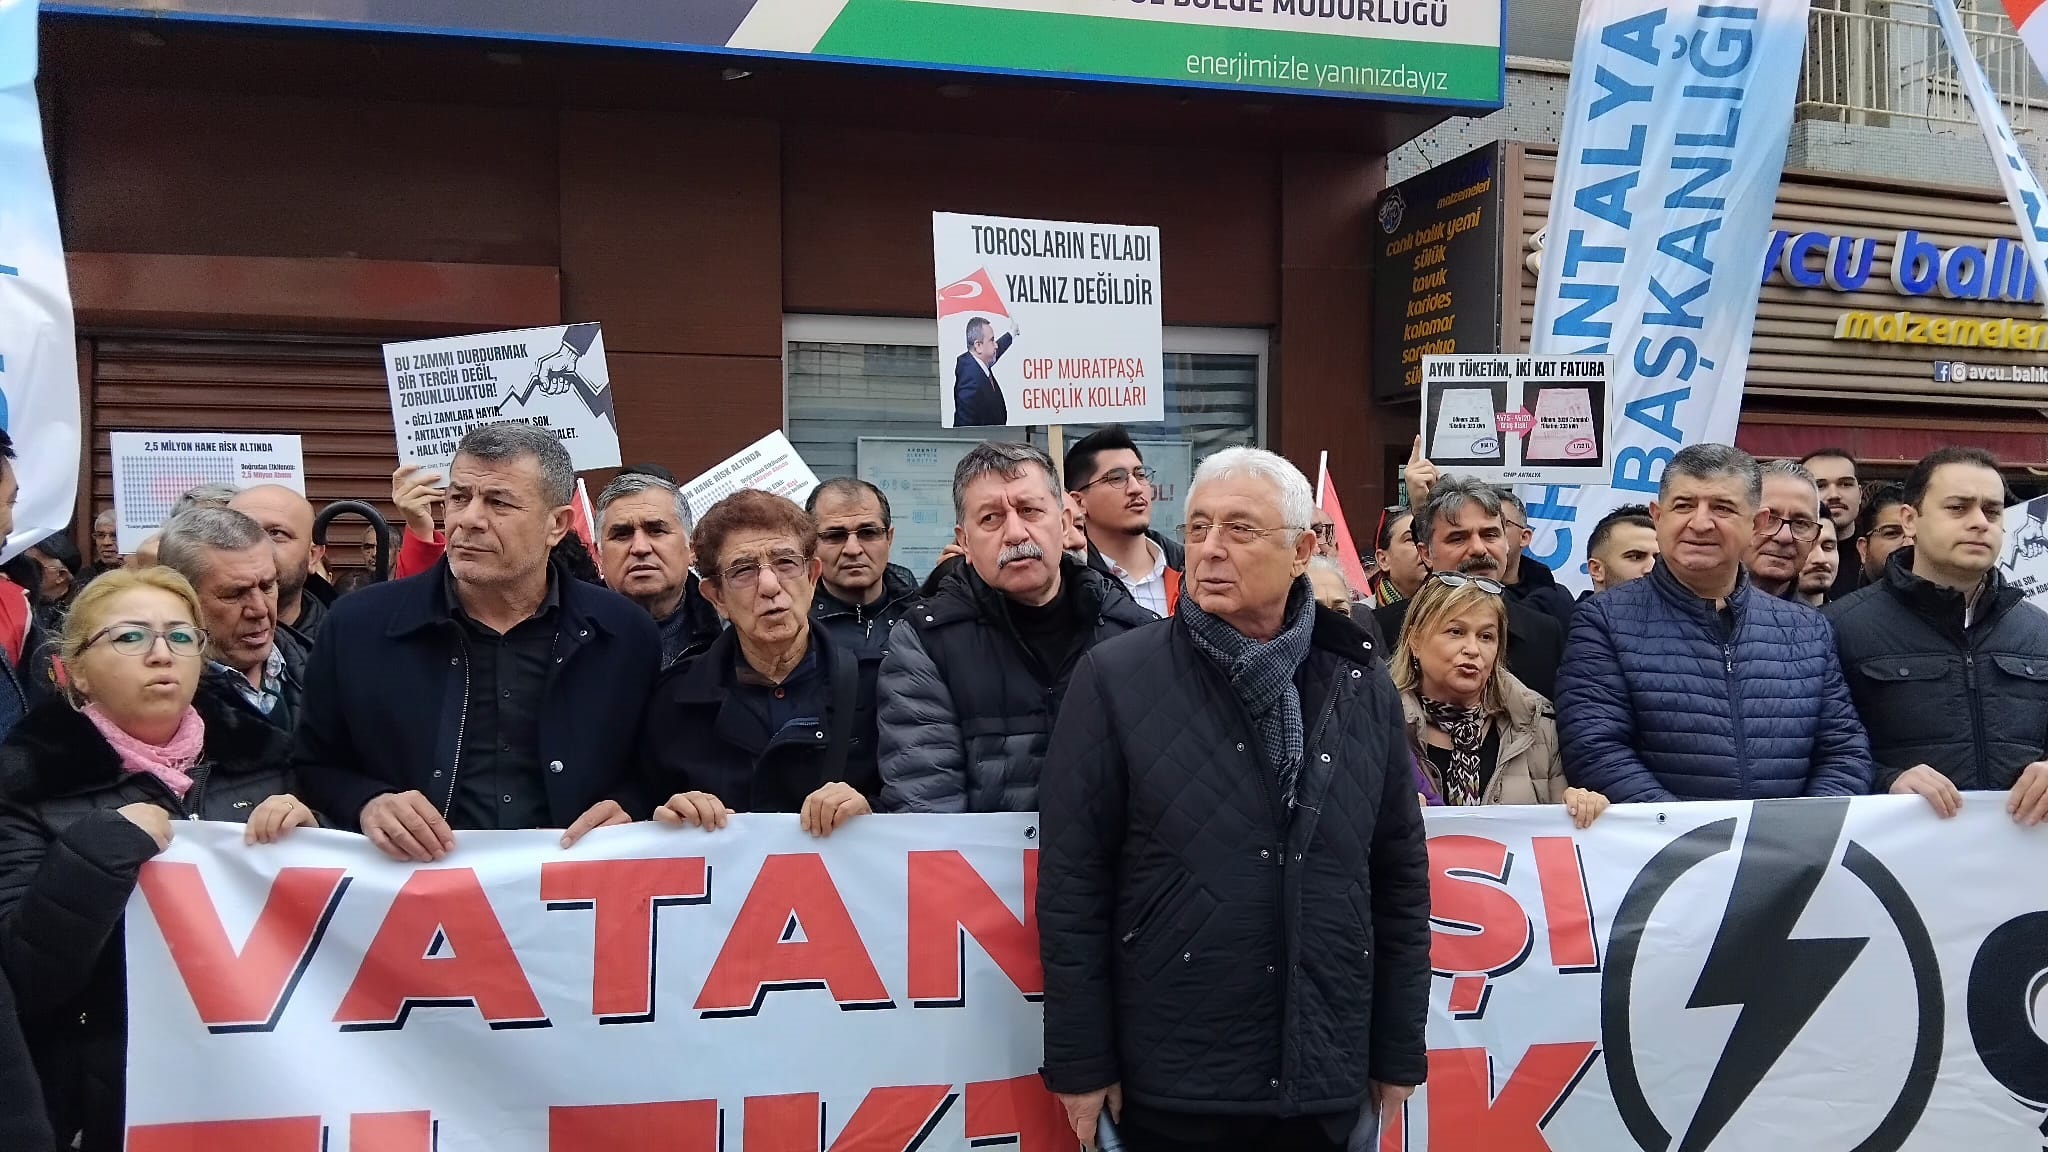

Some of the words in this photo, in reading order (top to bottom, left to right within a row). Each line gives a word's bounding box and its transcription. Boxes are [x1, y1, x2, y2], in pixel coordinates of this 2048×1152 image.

[1186, 51, 1309, 83] enerjimizle
[1315, 63, 1448, 95] yanınızdayız
[1552, 7, 1667, 354] NTALYA
[1447, 206, 1482, 241] yemi
[971, 225, 1085, 260] TOROSLARIN
[1090, 232, 1151, 261] EVLADI
[1611, 5, 1759, 494] BAŞKANLIĞI
[1413, 244, 1447, 271] sülük
[1005, 274, 1068, 304] YALNIZ
[1073, 272, 1152, 305] DEĞİLDİR
[1412, 267, 1448, 294] tavuk
[1406, 290, 1453, 318] karides
[1403, 314, 1456, 342] kalamar
[394, 357, 410, 372] BU
[414, 351, 455, 370] ZAMMI
[457, 344, 529, 366] DURDURMAK
[1023, 358, 1053, 380] CHP
[1058, 358, 1145, 384] MURATPAŞA
[1428, 362, 1455, 377] AYNI
[1458, 359, 1513, 379] TÜKETİM,
[1515, 359, 1532, 377] İKİ
[1534, 361, 1557, 377] KAT
[1560, 361, 1605, 377] FATURA
[397, 373, 416, 391] BİR
[419, 367, 458, 389] TERCİH
[462, 363, 498, 384] DEĞİL,
[399, 383, 498, 408] ZORUNLULUKTUR!
[1022, 382, 1083, 414] GENÇLİK
[1088, 386, 1147, 408] KOLLARI
[412, 411, 433, 427] GİZLİ
[434, 409, 475, 424] ZAMLARA
[144, 441, 159, 453] 2,5
[161, 440, 193, 452] MİLYON
[195, 442, 217, 452] HANE
[219, 440, 238, 452] RİSK
[239, 442, 273, 453] ALTINDA
[416, 442, 439, 457] HALK
[439, 439, 457, 457] İÇİN
[730, 450, 762, 473] ALTINDA
